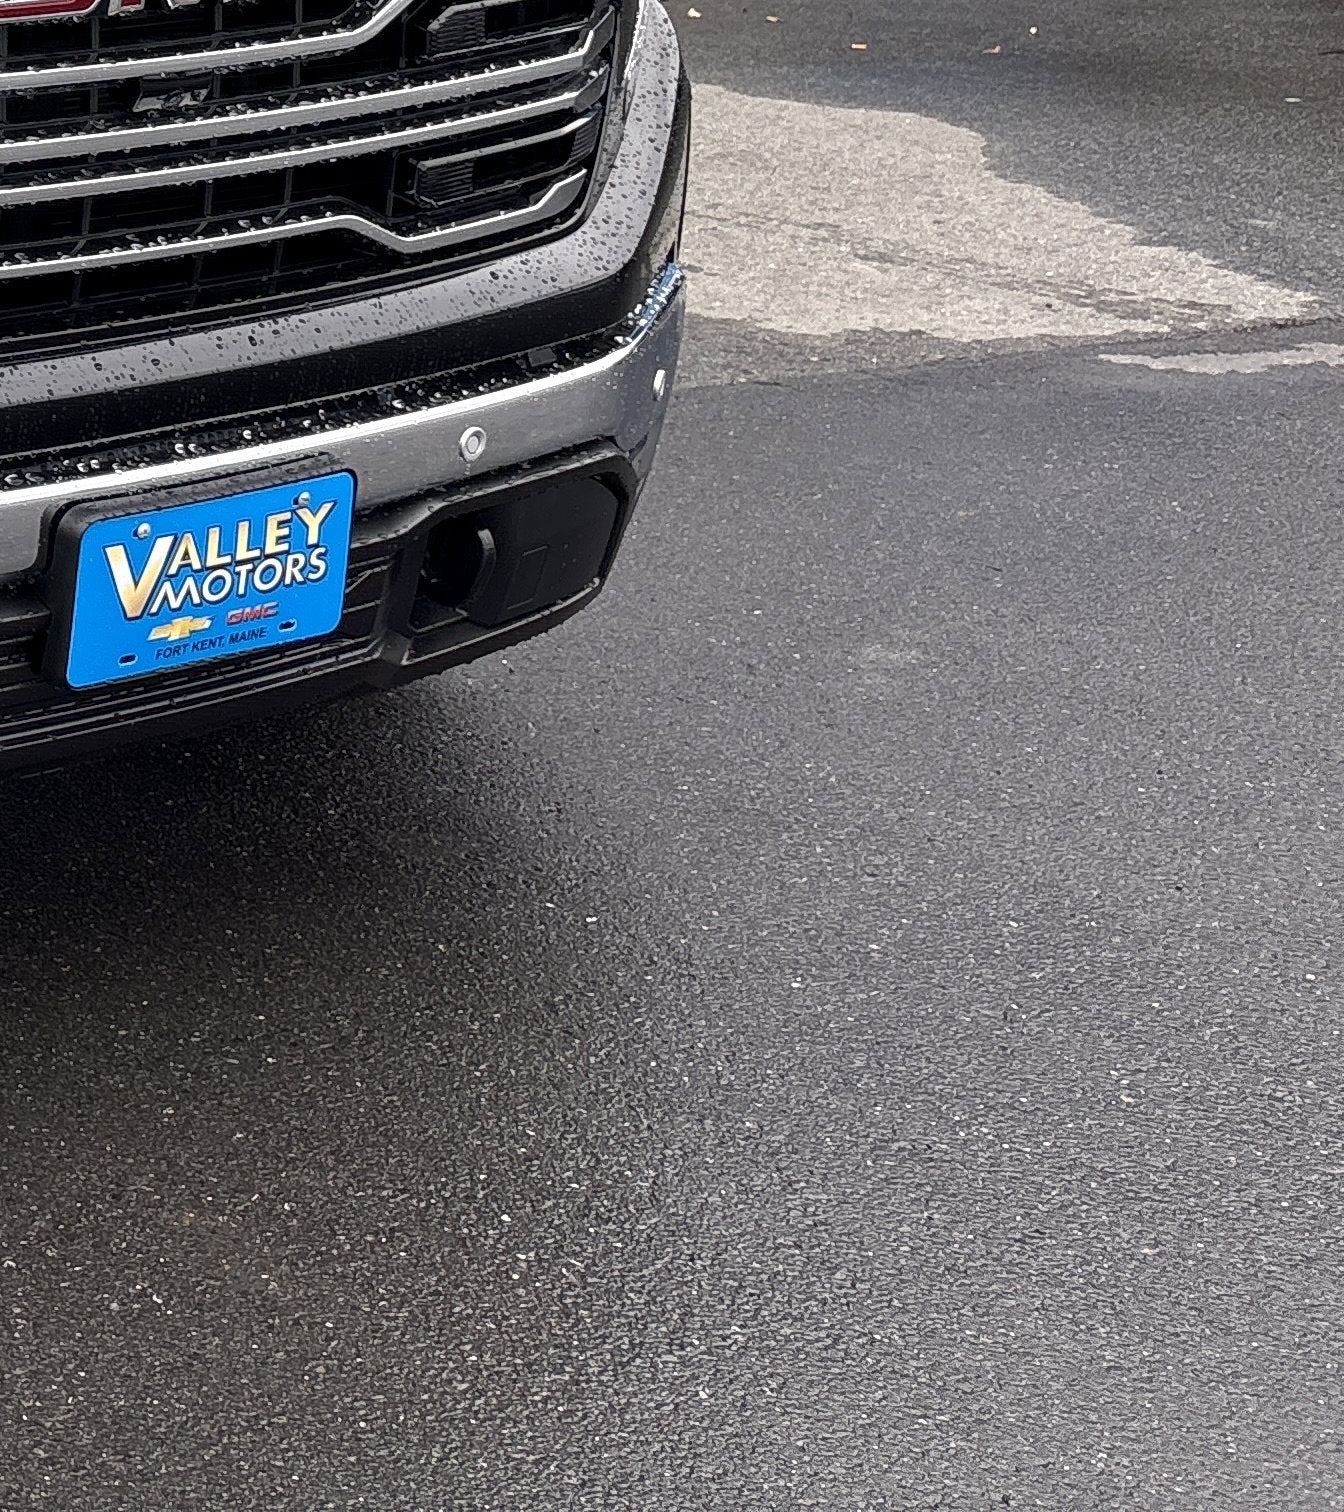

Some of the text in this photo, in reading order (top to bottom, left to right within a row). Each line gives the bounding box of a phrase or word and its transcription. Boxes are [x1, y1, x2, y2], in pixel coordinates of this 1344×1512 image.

[104, 501, 336, 620] VALLEY
[149, 546, 328, 615] MOTORS
[227, 601, 279, 626] GMC
[155, 642, 191, 661] FORT
[228, 626, 268, 645] MAINE
